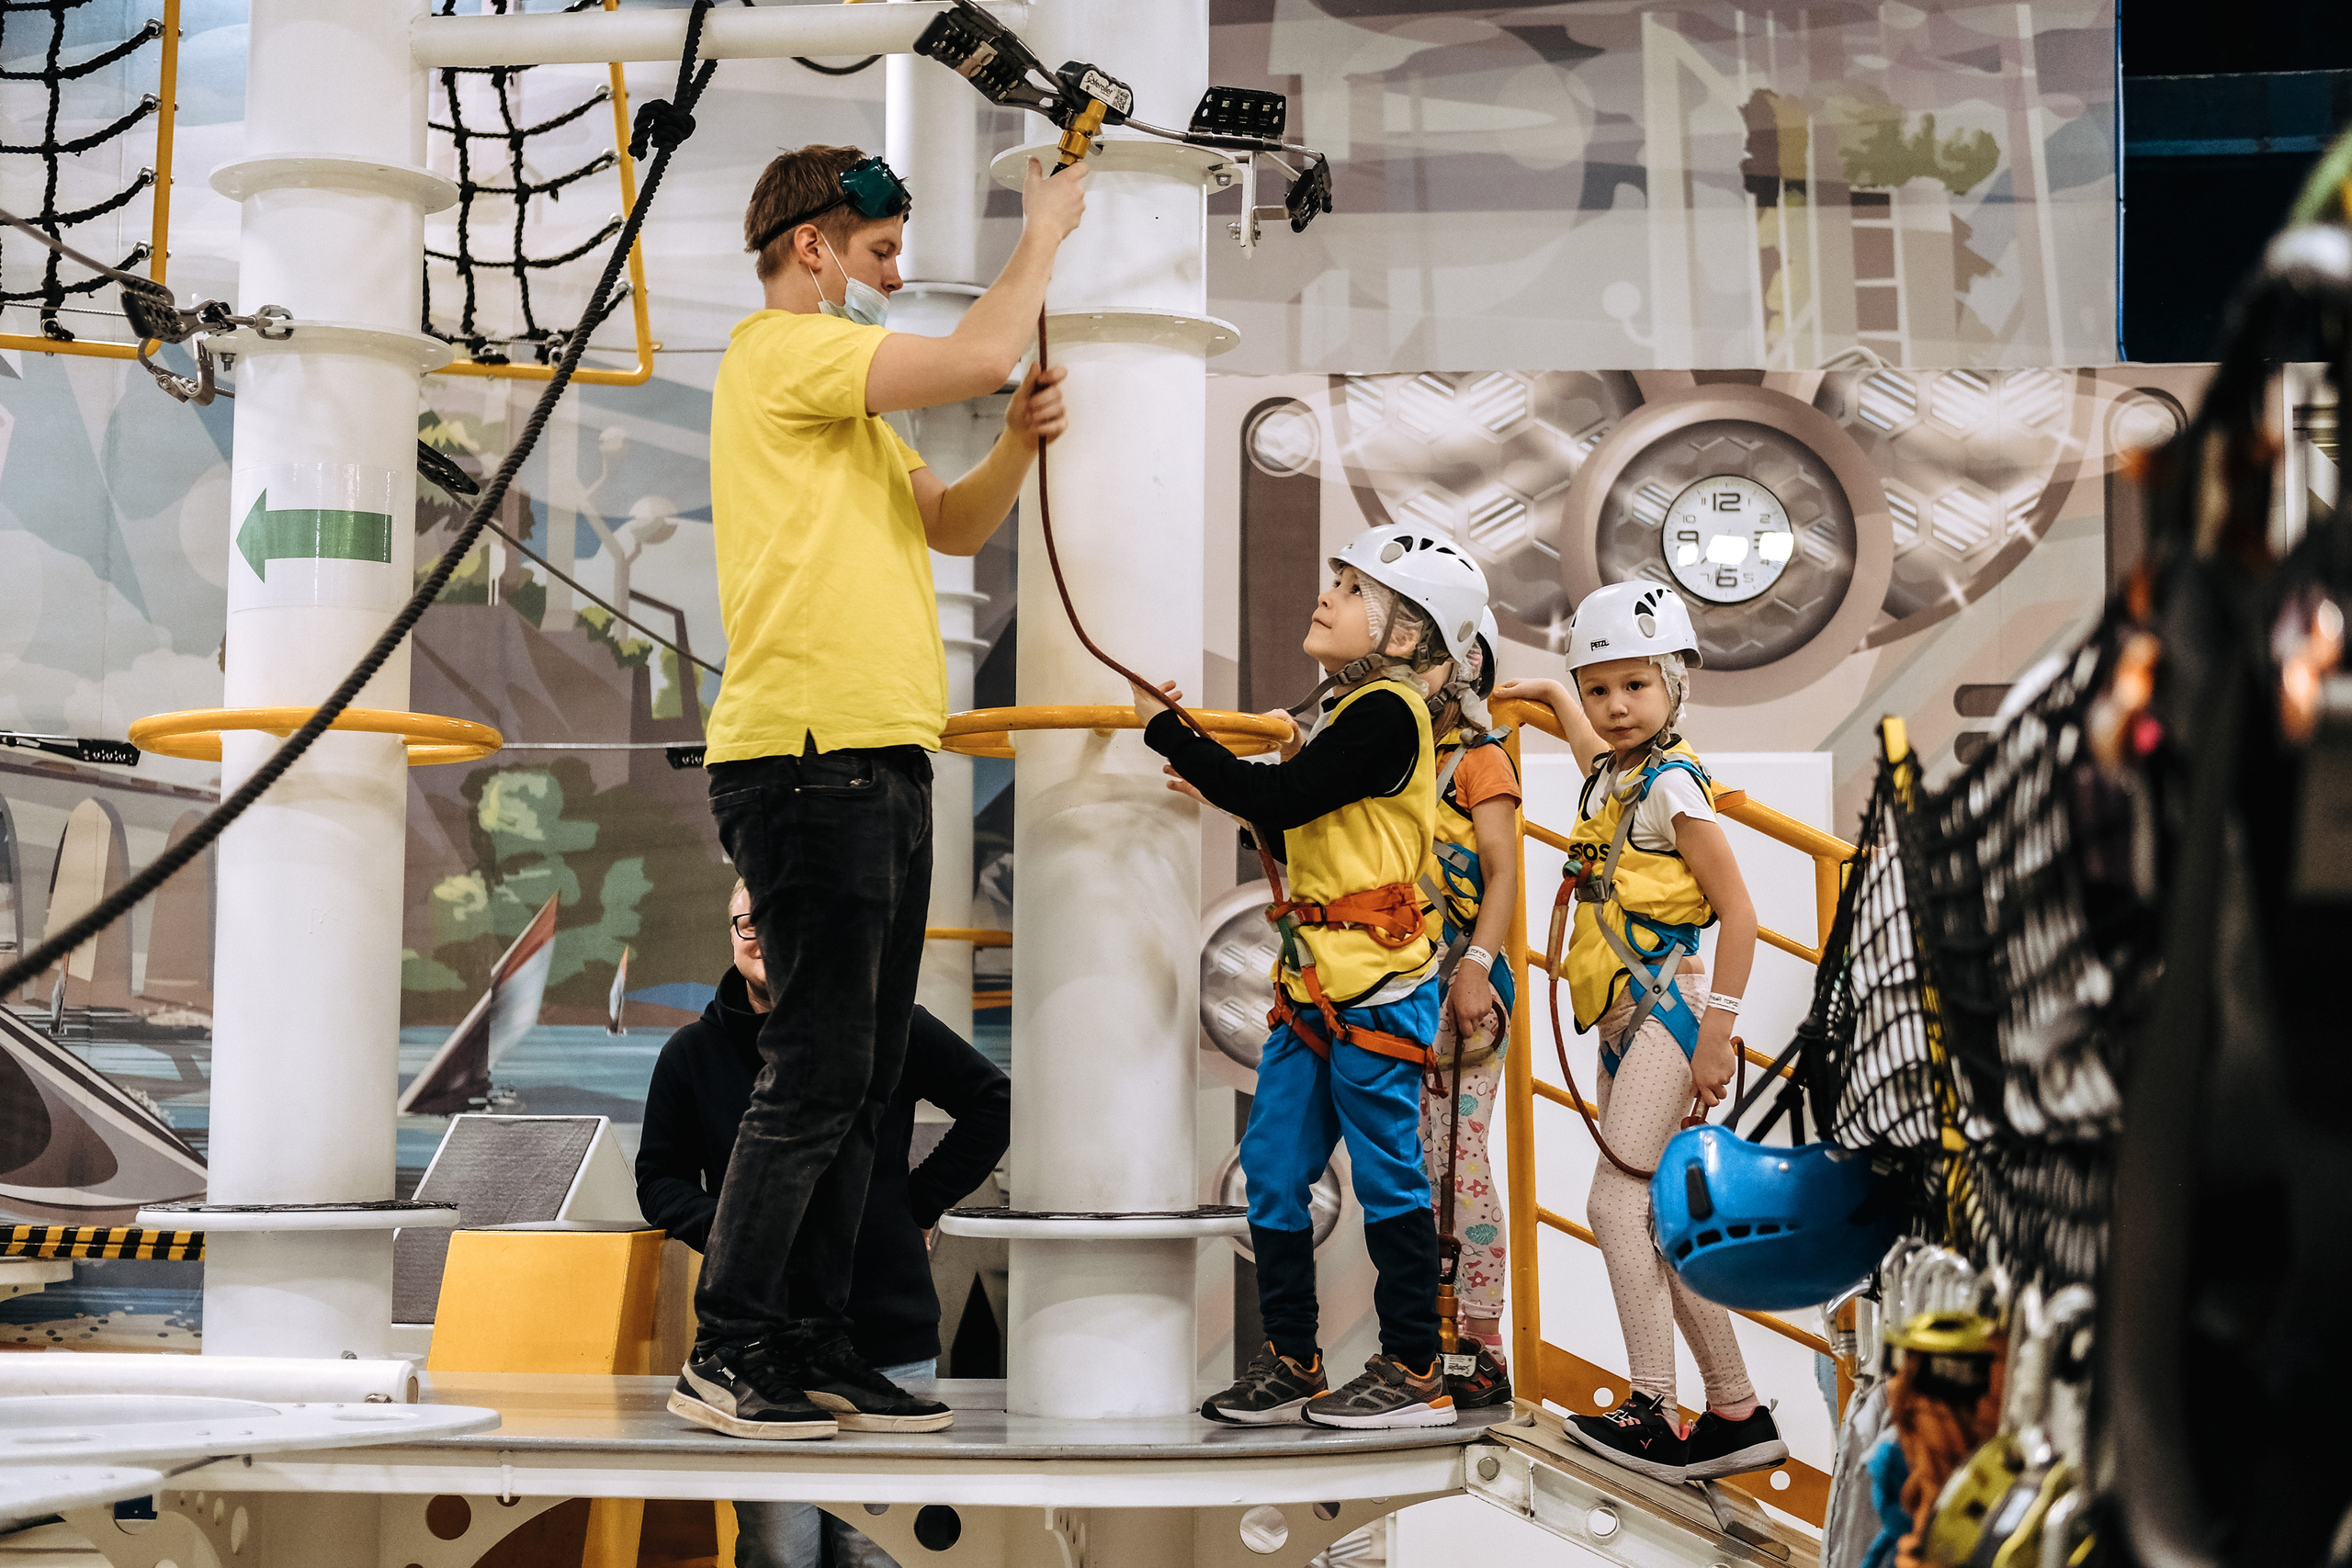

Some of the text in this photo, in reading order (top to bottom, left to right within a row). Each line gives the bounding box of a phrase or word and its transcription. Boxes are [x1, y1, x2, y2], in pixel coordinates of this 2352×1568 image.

[1713, 492, 1741, 512] 12
[1682, 514, 1696, 524] 10
[1758, 513, 1770, 525] 2
[1677, 530, 1699, 549] 9
[1715, 567, 1738, 588] 6
[1743, 573, 1754, 583] 5
[1590, 639, 1610, 651] PETZL
